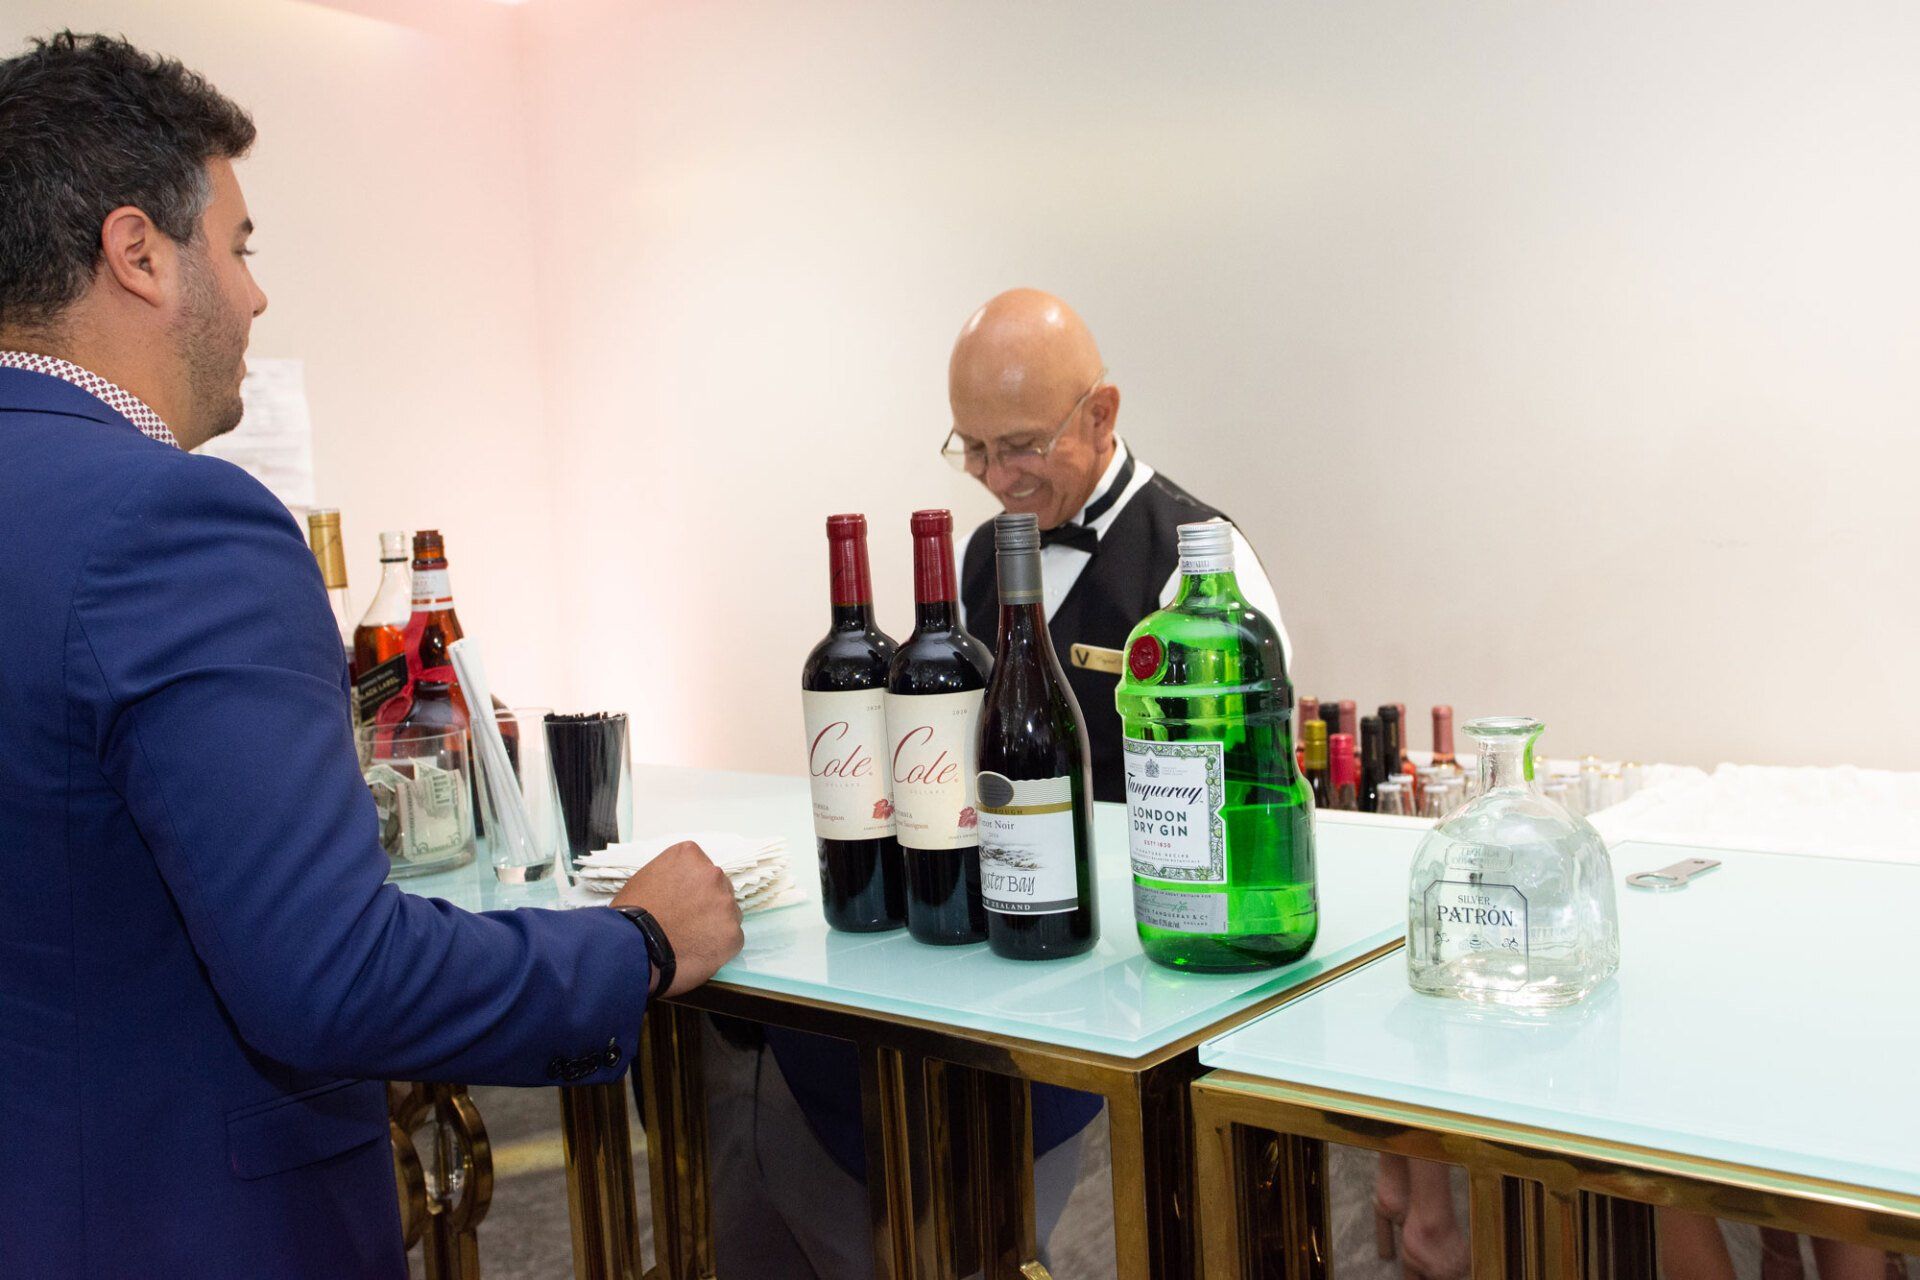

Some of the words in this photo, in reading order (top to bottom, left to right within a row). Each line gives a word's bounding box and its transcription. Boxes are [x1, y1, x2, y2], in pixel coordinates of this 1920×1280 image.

[1075, 649, 1090, 666] V
[810, 721, 872, 778] Cole
[893, 725, 958, 785] Cole
[1127, 772, 1203, 806] Tanqueray
[1133, 805, 1187, 822] LONDON
[994, 819, 1015, 830] Noir
[1134, 820, 1154, 834] DRY
[1160, 824, 1188, 837] GIN
[981, 869, 1006, 892] yster
[1007, 874, 1036, 896] Bay
[992, 901, 1031, 911] ZEALAND
[1457, 894, 1491, 906] SILVER
[1437, 904, 1514, 928] PATRÓN
